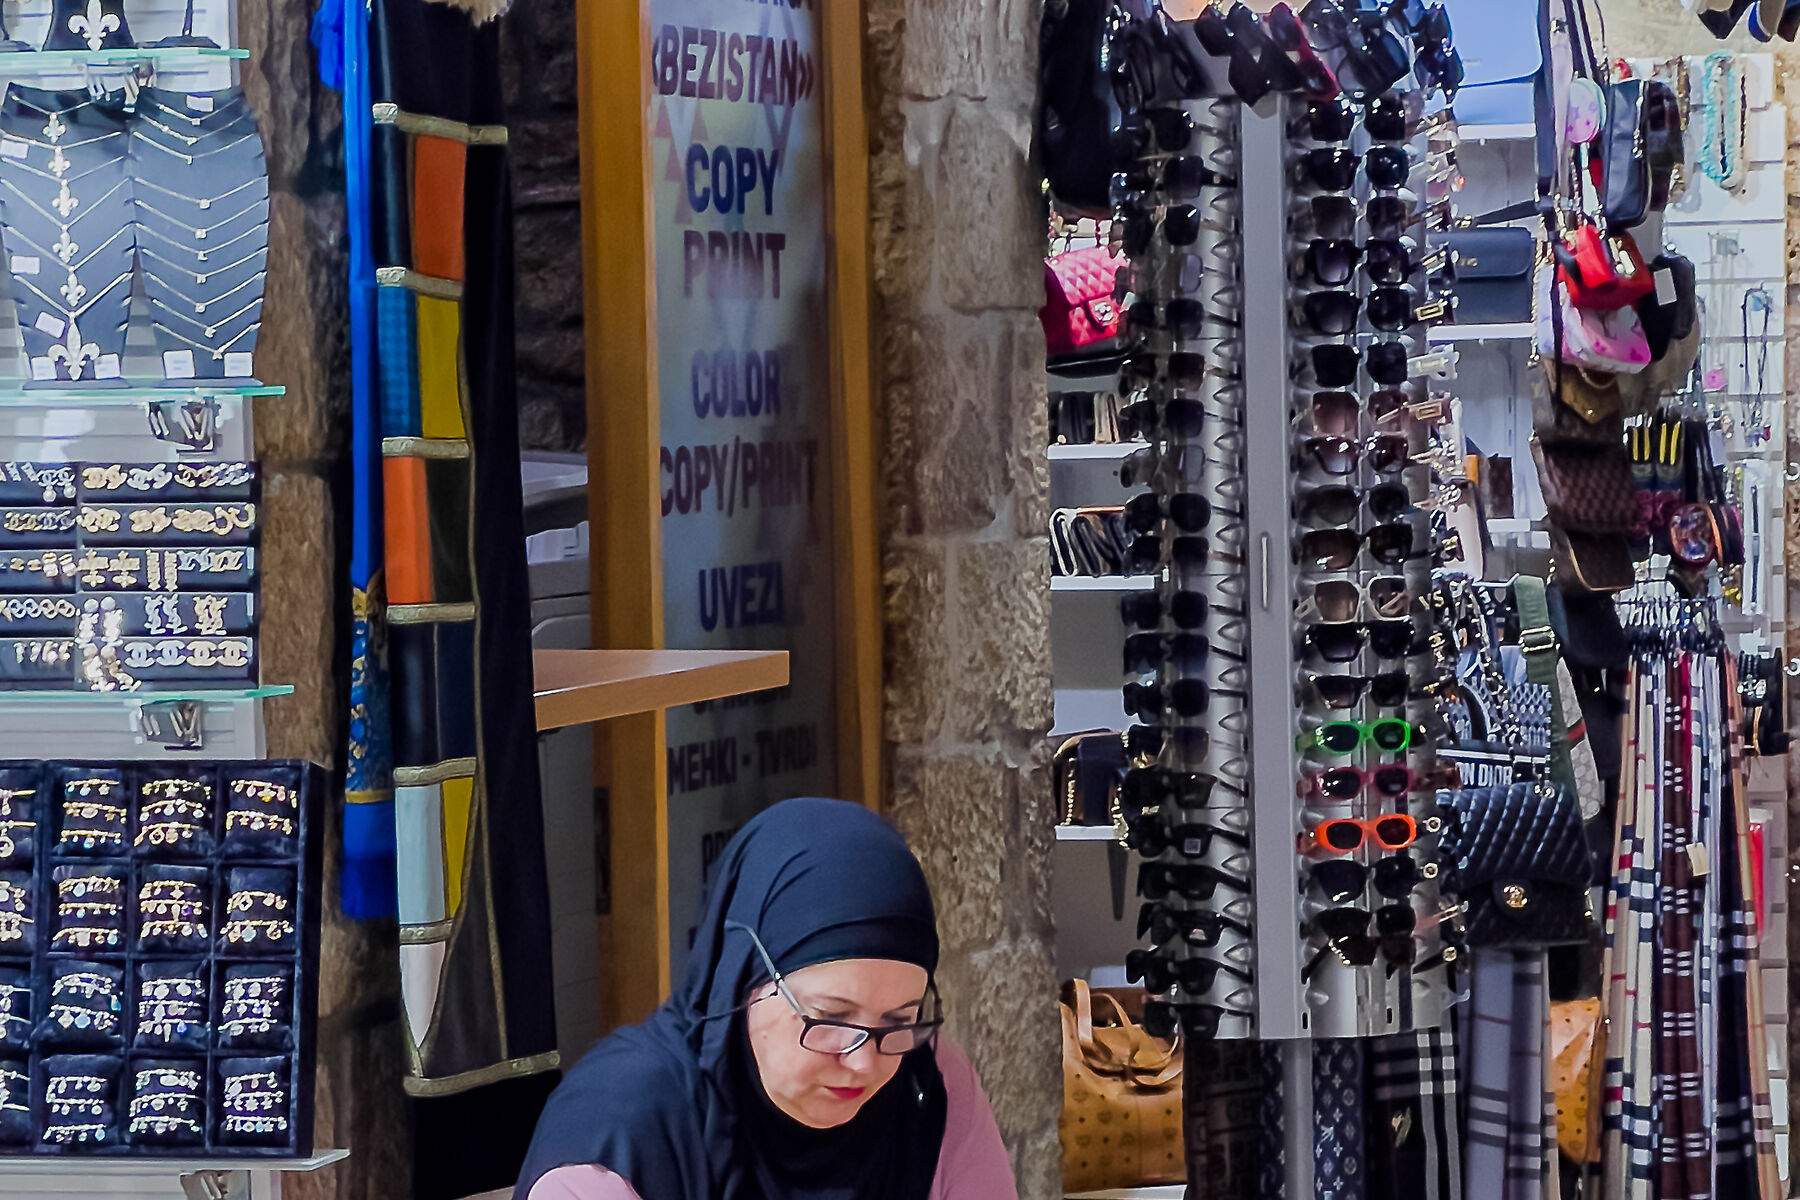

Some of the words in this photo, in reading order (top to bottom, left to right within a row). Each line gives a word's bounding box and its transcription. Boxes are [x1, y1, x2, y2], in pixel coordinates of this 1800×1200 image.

[685, 143, 781, 216] COPY
[683, 230, 786, 300] PRINT
[691, 349, 781, 420] COLOR
[660, 435, 819, 518] COPY/PRINT
[698, 561, 784, 632] UVEZI
[667, 736, 737, 795] MEHKI
[755, 722, 818, 777] TVRDI
[1478, 763, 1513, 788] DIOR
